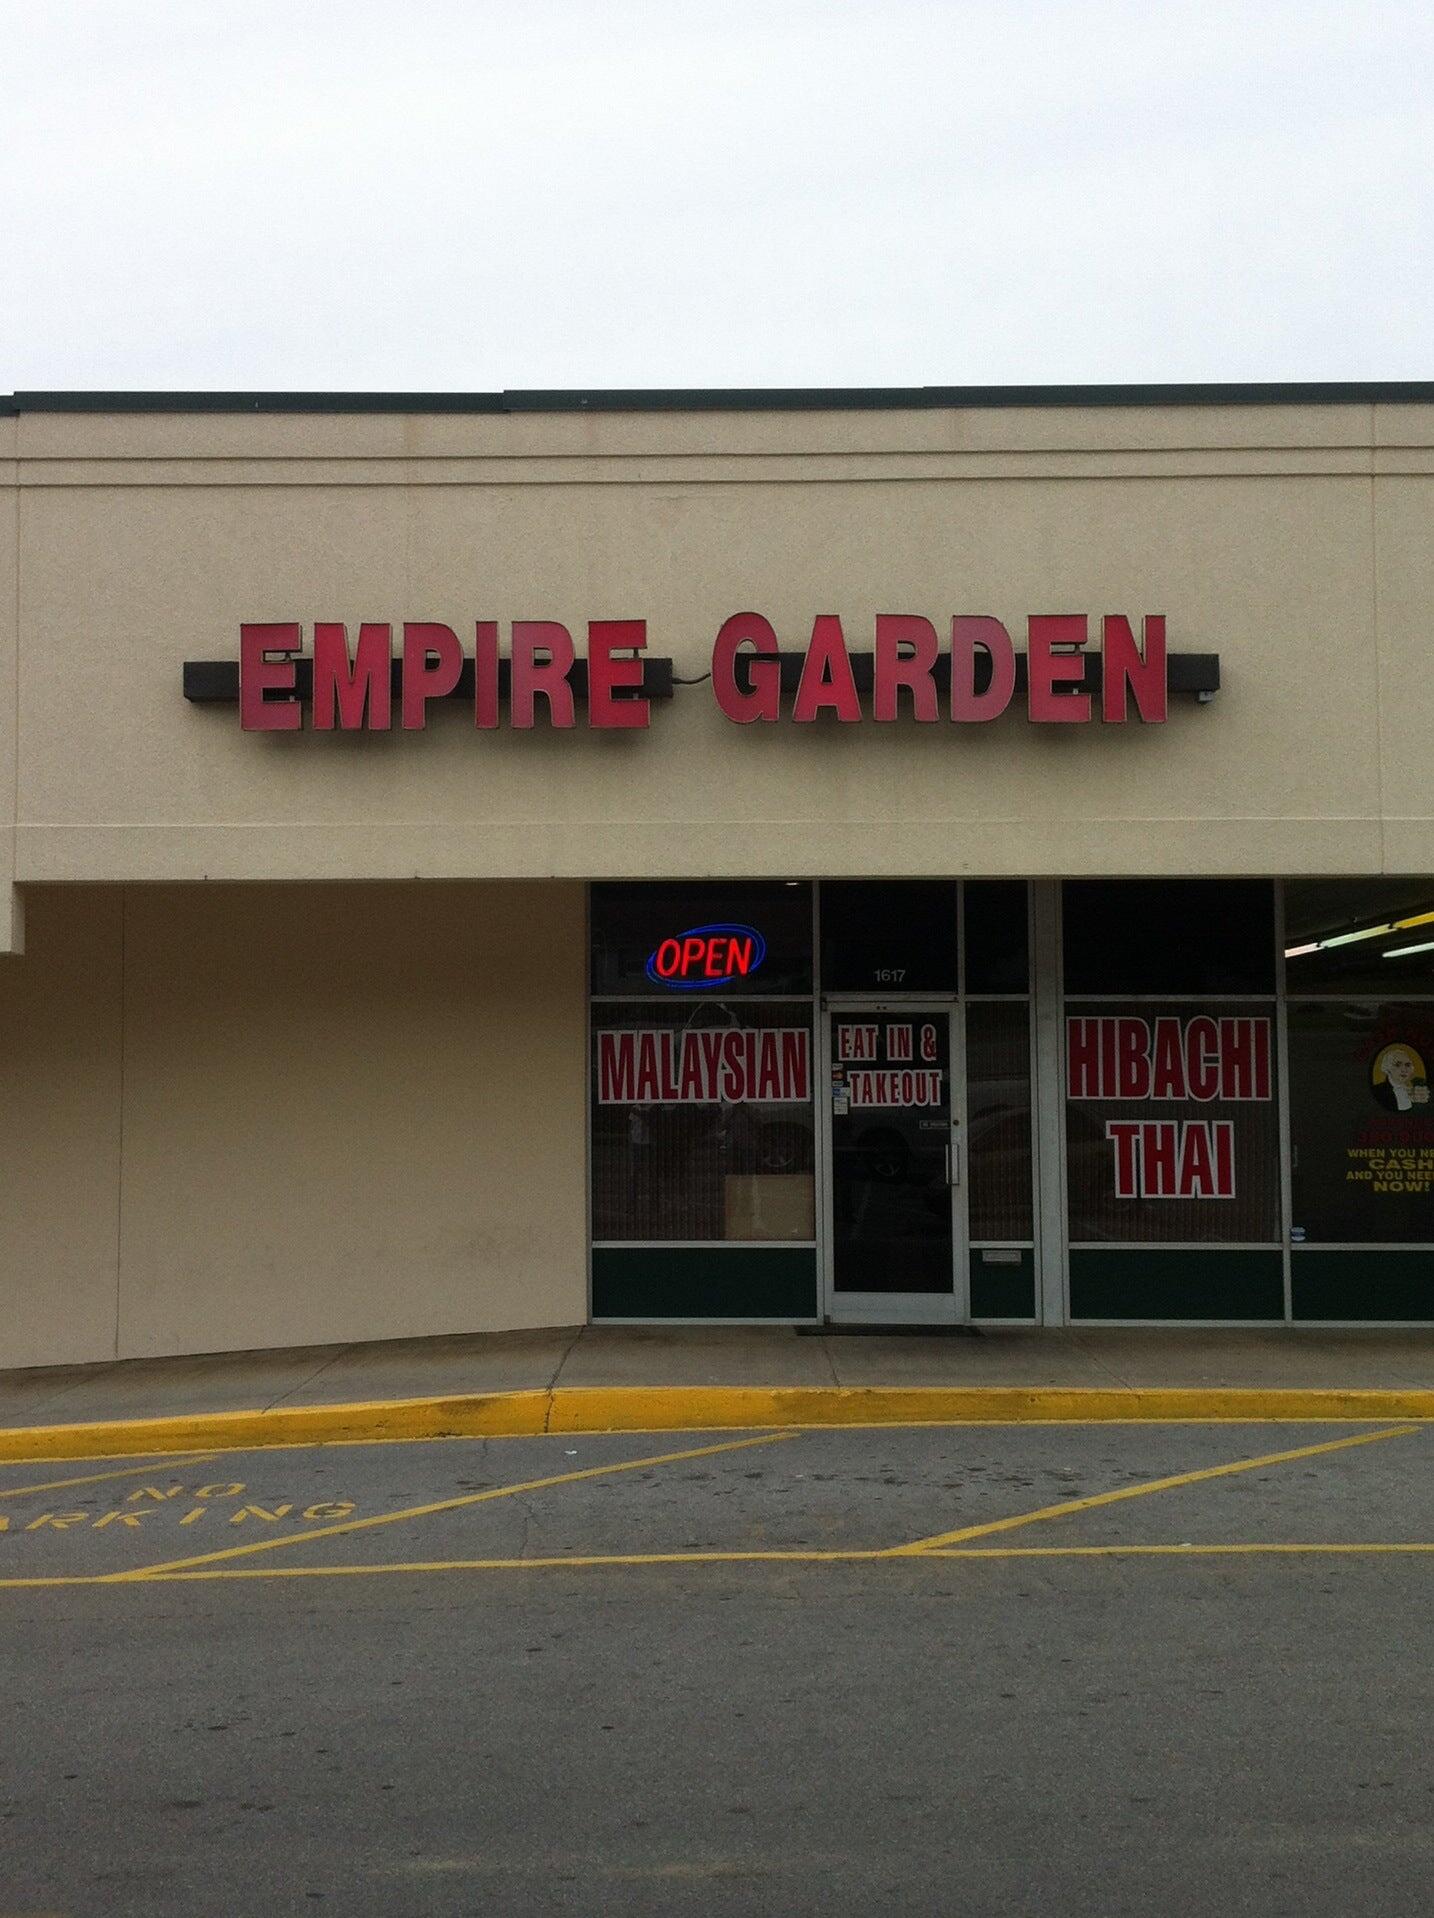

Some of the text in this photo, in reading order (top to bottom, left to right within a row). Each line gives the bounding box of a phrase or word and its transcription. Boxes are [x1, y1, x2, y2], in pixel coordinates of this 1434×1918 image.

[240, 611, 1167, 731] EMPIRE GARDEN
[655, 937, 752, 977] OPEN
[873, 969, 906, 982] 1617
[839, 1025, 937, 1060] EAT IN &
[1067, 1016, 1271, 1101] HIBACHI
[599, 1028, 809, 1102] MALAYSIAN
[848, 1070, 941, 1106] TAKEOUT
[1106, 1120, 1236, 1199] THAI
[1347, 1148, 1386, 1158] WHEN
[1389, 1148, 1416, 1158] YOU
[1368, 1159, 1434, 1170] CASH
[1346, 1170, 1434, 1180] AND YOU NEE
[1373, 1181, 1430, 1192] NOW!
[126, 1482, 247, 1501] NO
